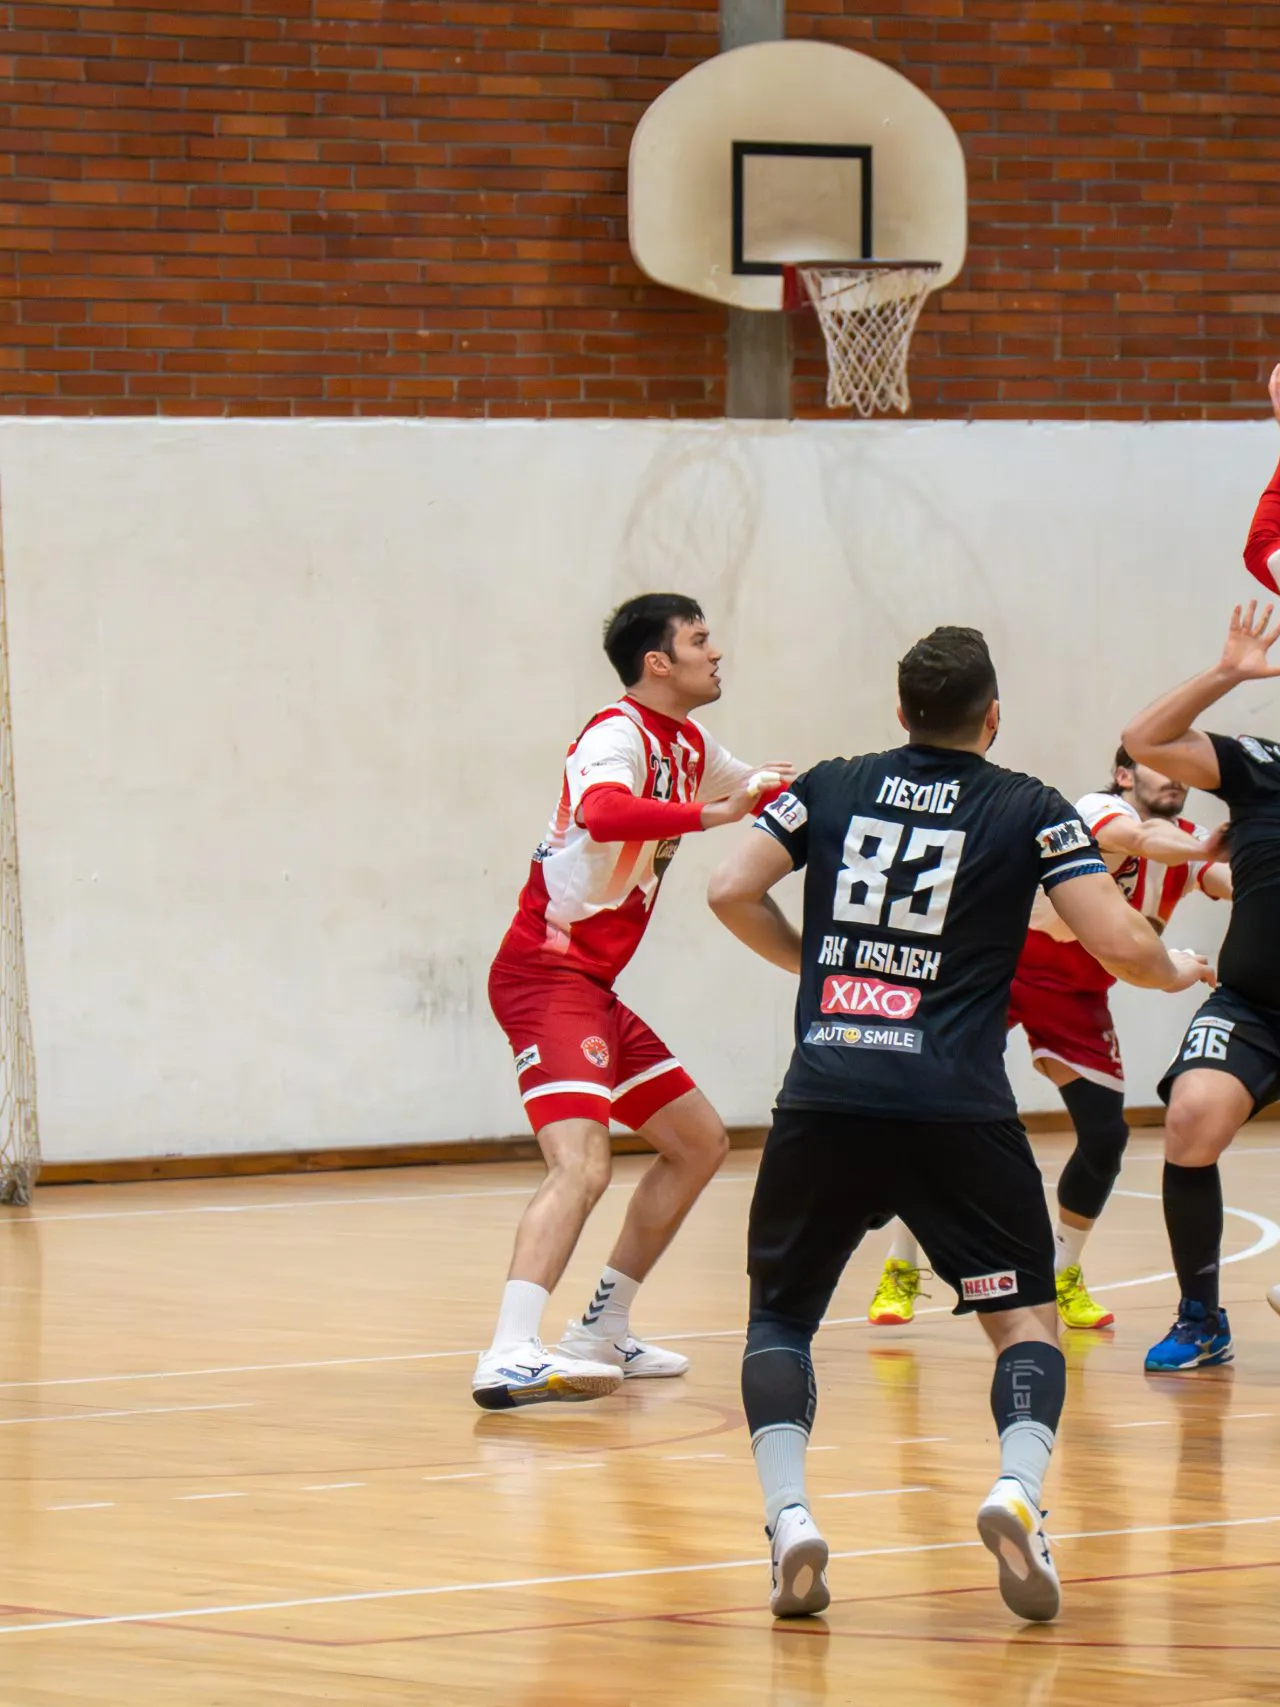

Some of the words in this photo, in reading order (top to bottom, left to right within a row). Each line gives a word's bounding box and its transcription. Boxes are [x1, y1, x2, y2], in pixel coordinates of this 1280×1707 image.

[832, 815, 967, 936] 83
[855, 940, 942, 980] OSIJEK
[827, 980, 914, 1016] XIXO
[863, 1030, 915, 1047] SMILE
[1182, 1026, 1230, 1061] 36
